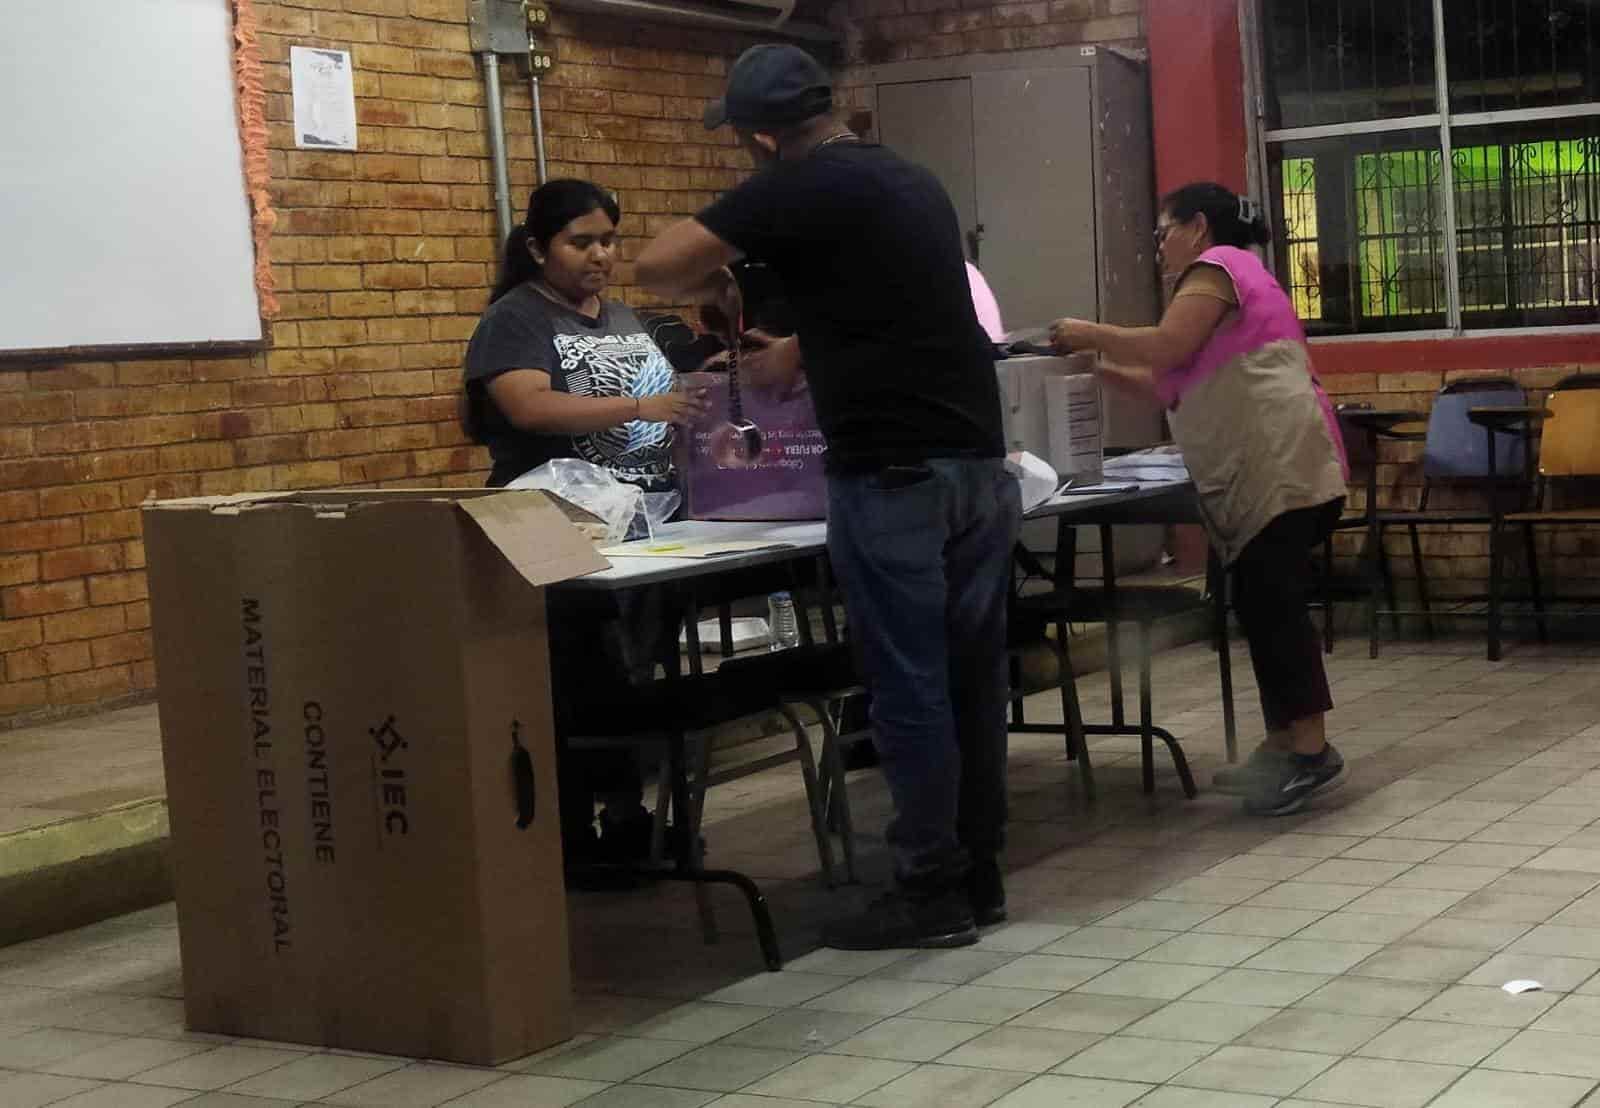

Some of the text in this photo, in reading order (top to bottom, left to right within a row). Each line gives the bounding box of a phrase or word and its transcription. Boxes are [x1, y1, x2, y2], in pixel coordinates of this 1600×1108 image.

[241, 598, 292, 954] MATERIAL ELECTORAL
[303, 701, 335, 865] CONTIENE
[381, 769, 408, 835] IEC
